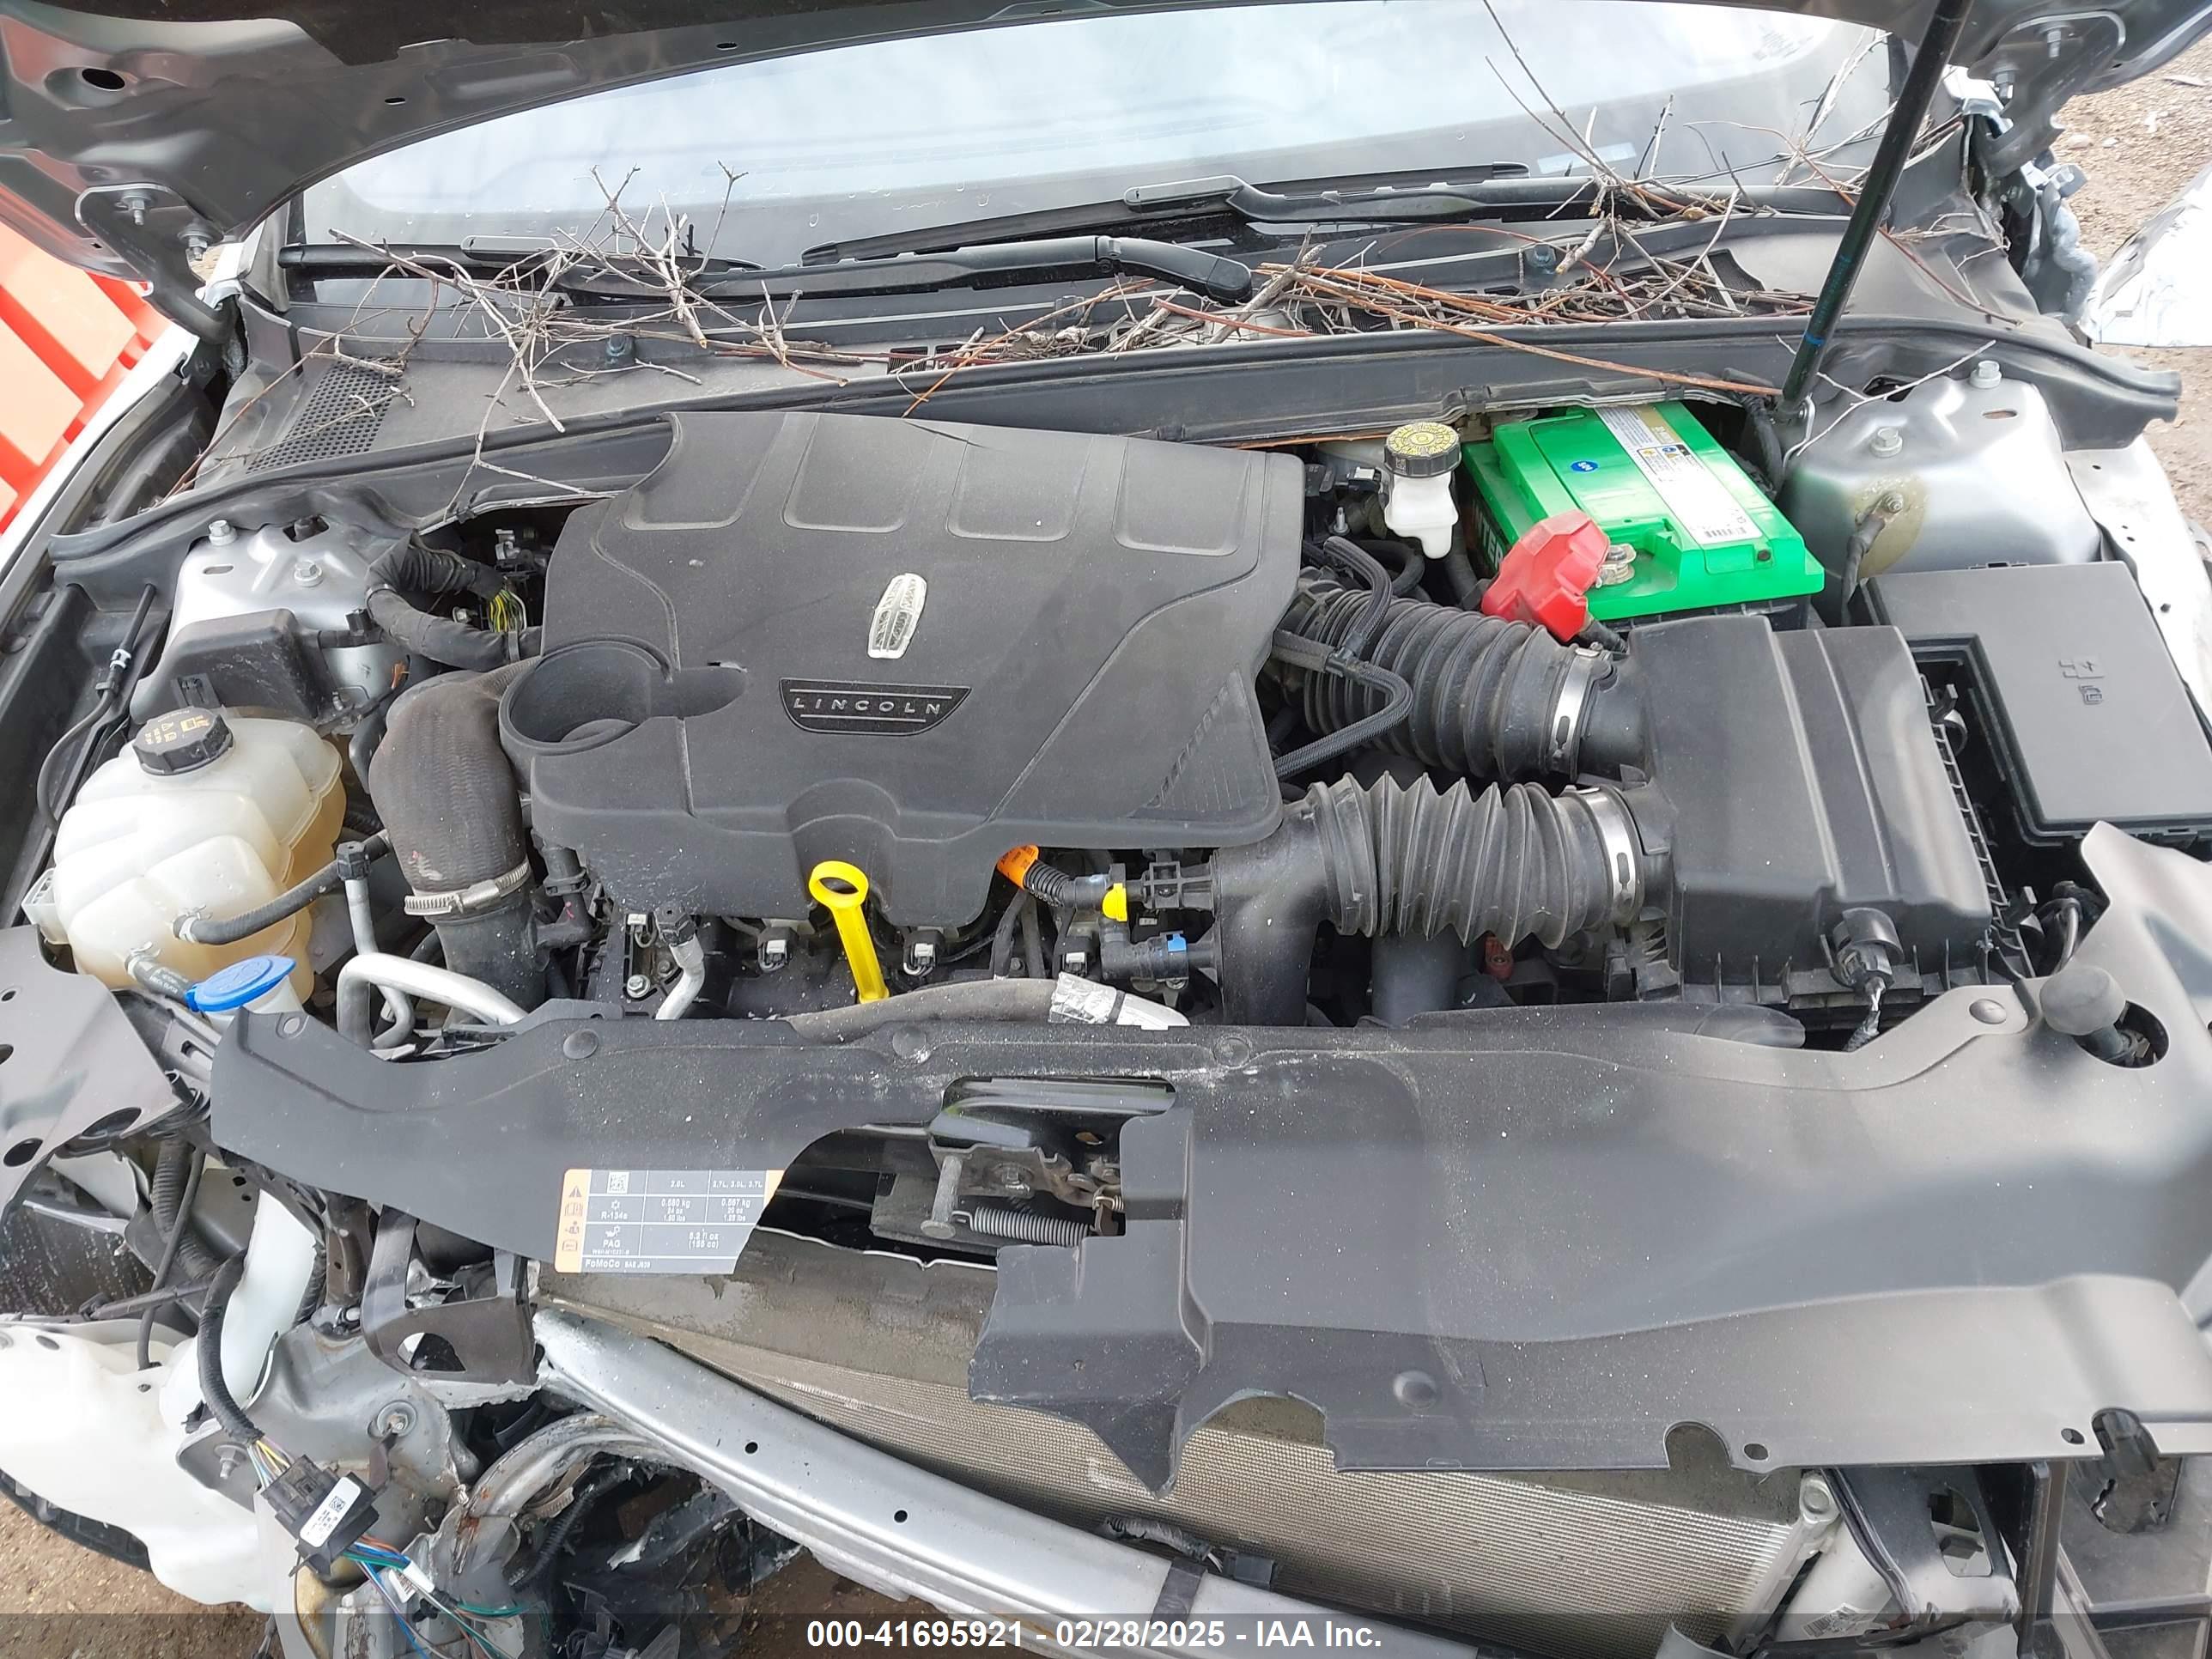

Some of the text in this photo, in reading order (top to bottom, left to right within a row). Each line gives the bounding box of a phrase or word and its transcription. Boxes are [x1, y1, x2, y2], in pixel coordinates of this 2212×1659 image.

[793, 697, 940, 714] LINCOLN
[681, 1199, 690, 1209] kg
[740, 1199, 750, 1209] kg
[600, 1211, 628, 1220] R-134a
[603, 1239, 621, 1249] PAG
[585, 1259, 620, 1268] FoMoCo
